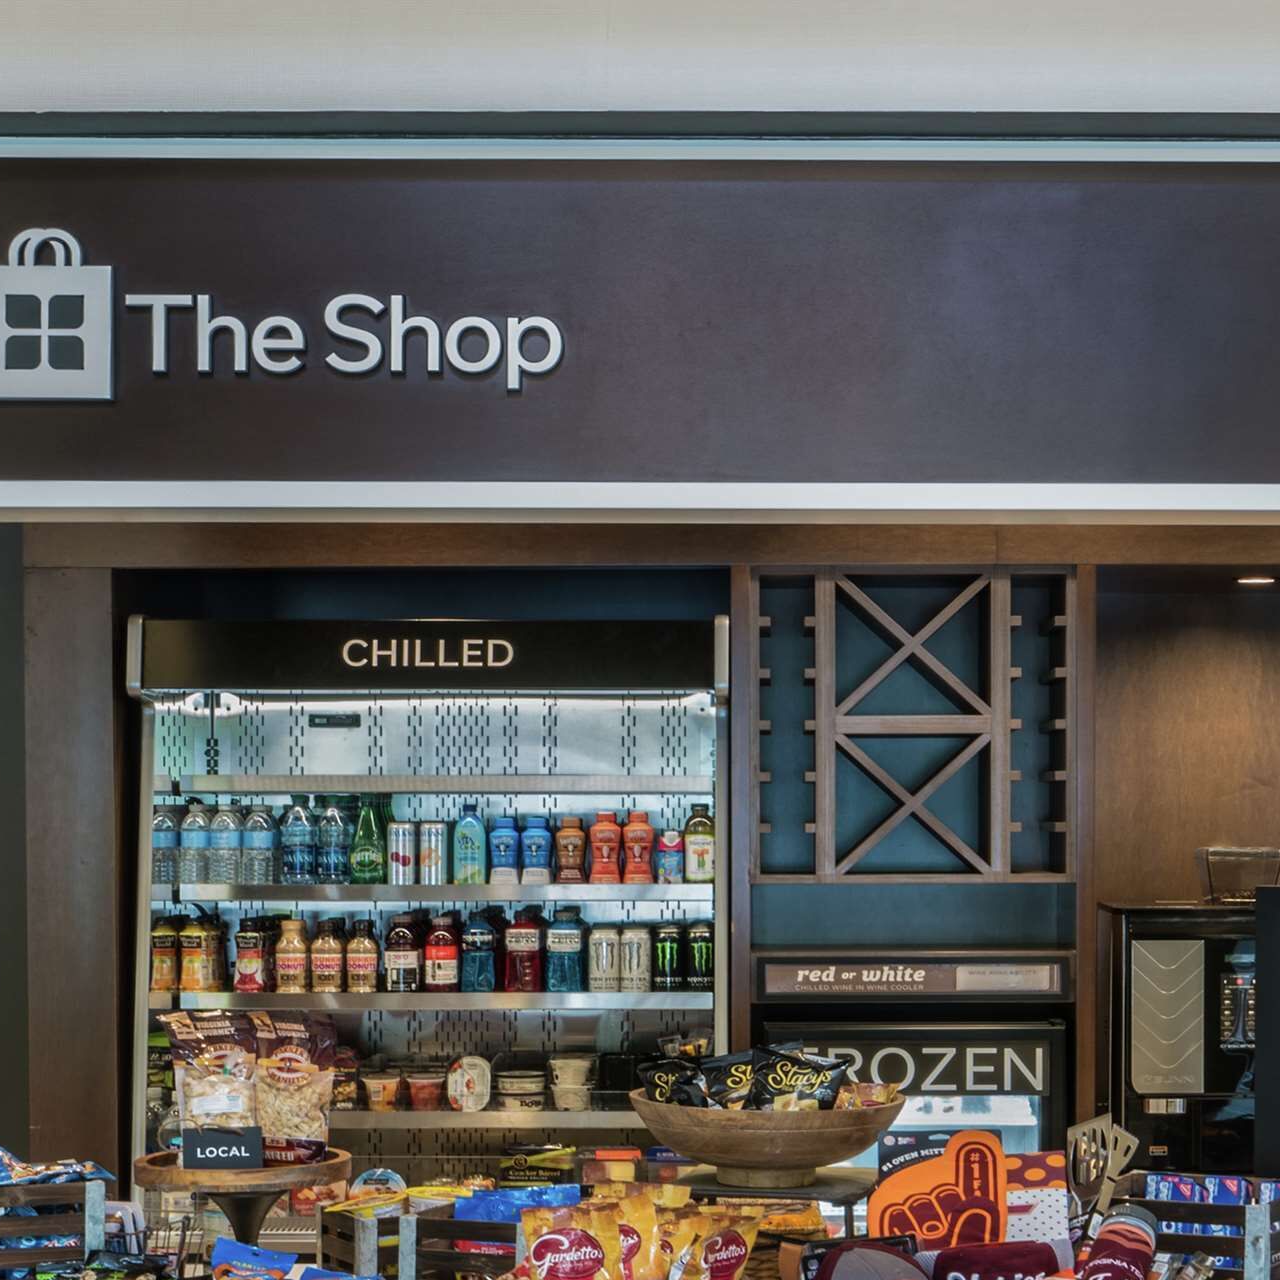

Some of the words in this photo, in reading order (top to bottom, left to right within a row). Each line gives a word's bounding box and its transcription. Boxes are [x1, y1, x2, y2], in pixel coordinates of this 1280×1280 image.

[125, 294, 306, 375] The
[323, 293, 563, 392] Shop
[341, 638, 515, 669] CHILLED
[796, 966, 835, 982] red
[841, 970, 856, 980] or
[862, 966, 926, 982] white
[768, 1061, 832, 1093] Stacy's
[196, 1146, 250, 1158] LOCAL
[892, 1152, 919, 1165] OVEN
[531, 1234, 604, 1280] Gardetto's
